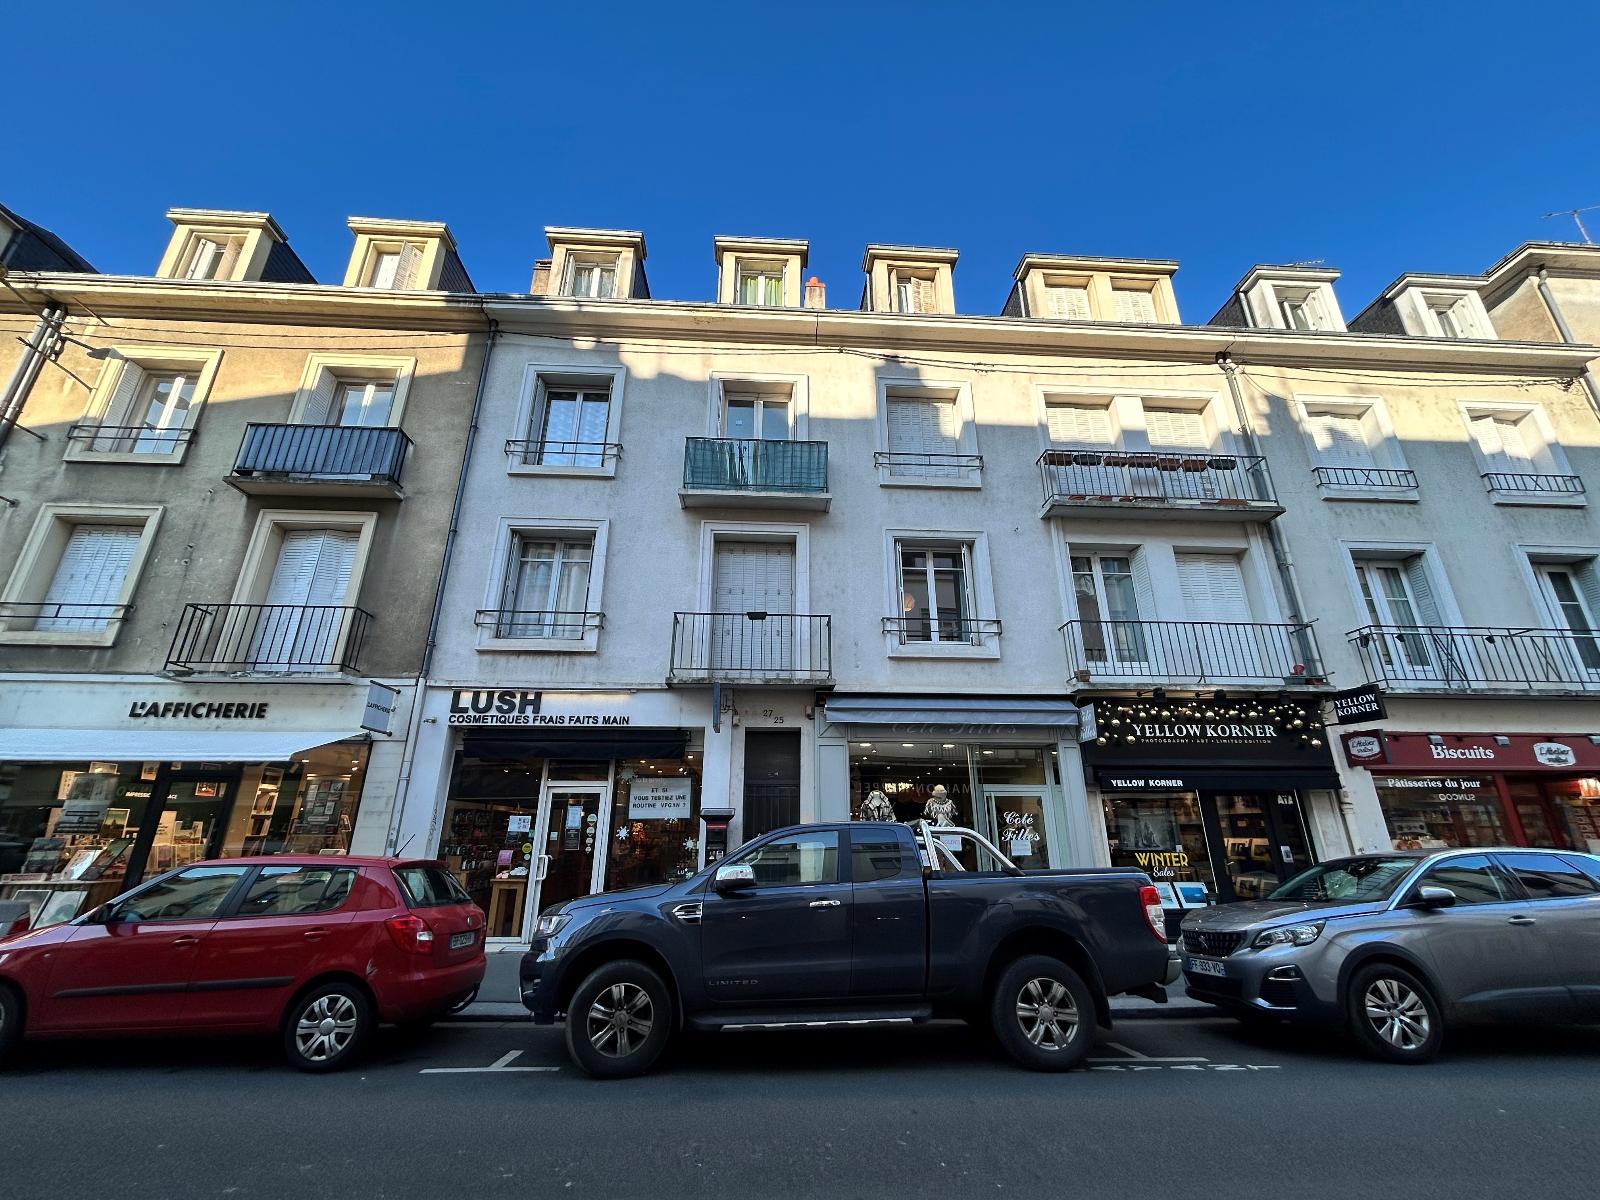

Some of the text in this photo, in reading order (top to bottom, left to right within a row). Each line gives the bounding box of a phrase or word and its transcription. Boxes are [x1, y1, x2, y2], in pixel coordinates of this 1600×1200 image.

[450, 690, 543, 715] LUSH
[1334, 693, 1376, 708] YELLOW
[128, 701, 269, 719] L'AFFICHERIE
[762, 709, 774, 718] 27
[1336, 702, 1380, 717] KORNER
[449, 714, 630, 725] COSMETIQUES FRAIS FAITS MAIN
[773, 716, 785, 725] 25
[1132, 724, 1278, 738] YELLOW KORNER
[1430, 744, 1495, 760] Biscuits
[1110, 779, 1184, 787] YELLOW KORNER
[1387, 778, 1481, 790] Pâtisseries du jour
[1003, 811, 1034, 825] Côté
[1001, 828, 1041, 842] Filles
[1134, 852, 1189, 867] WINTER
[1153, 866, 1175, 878] Sales
